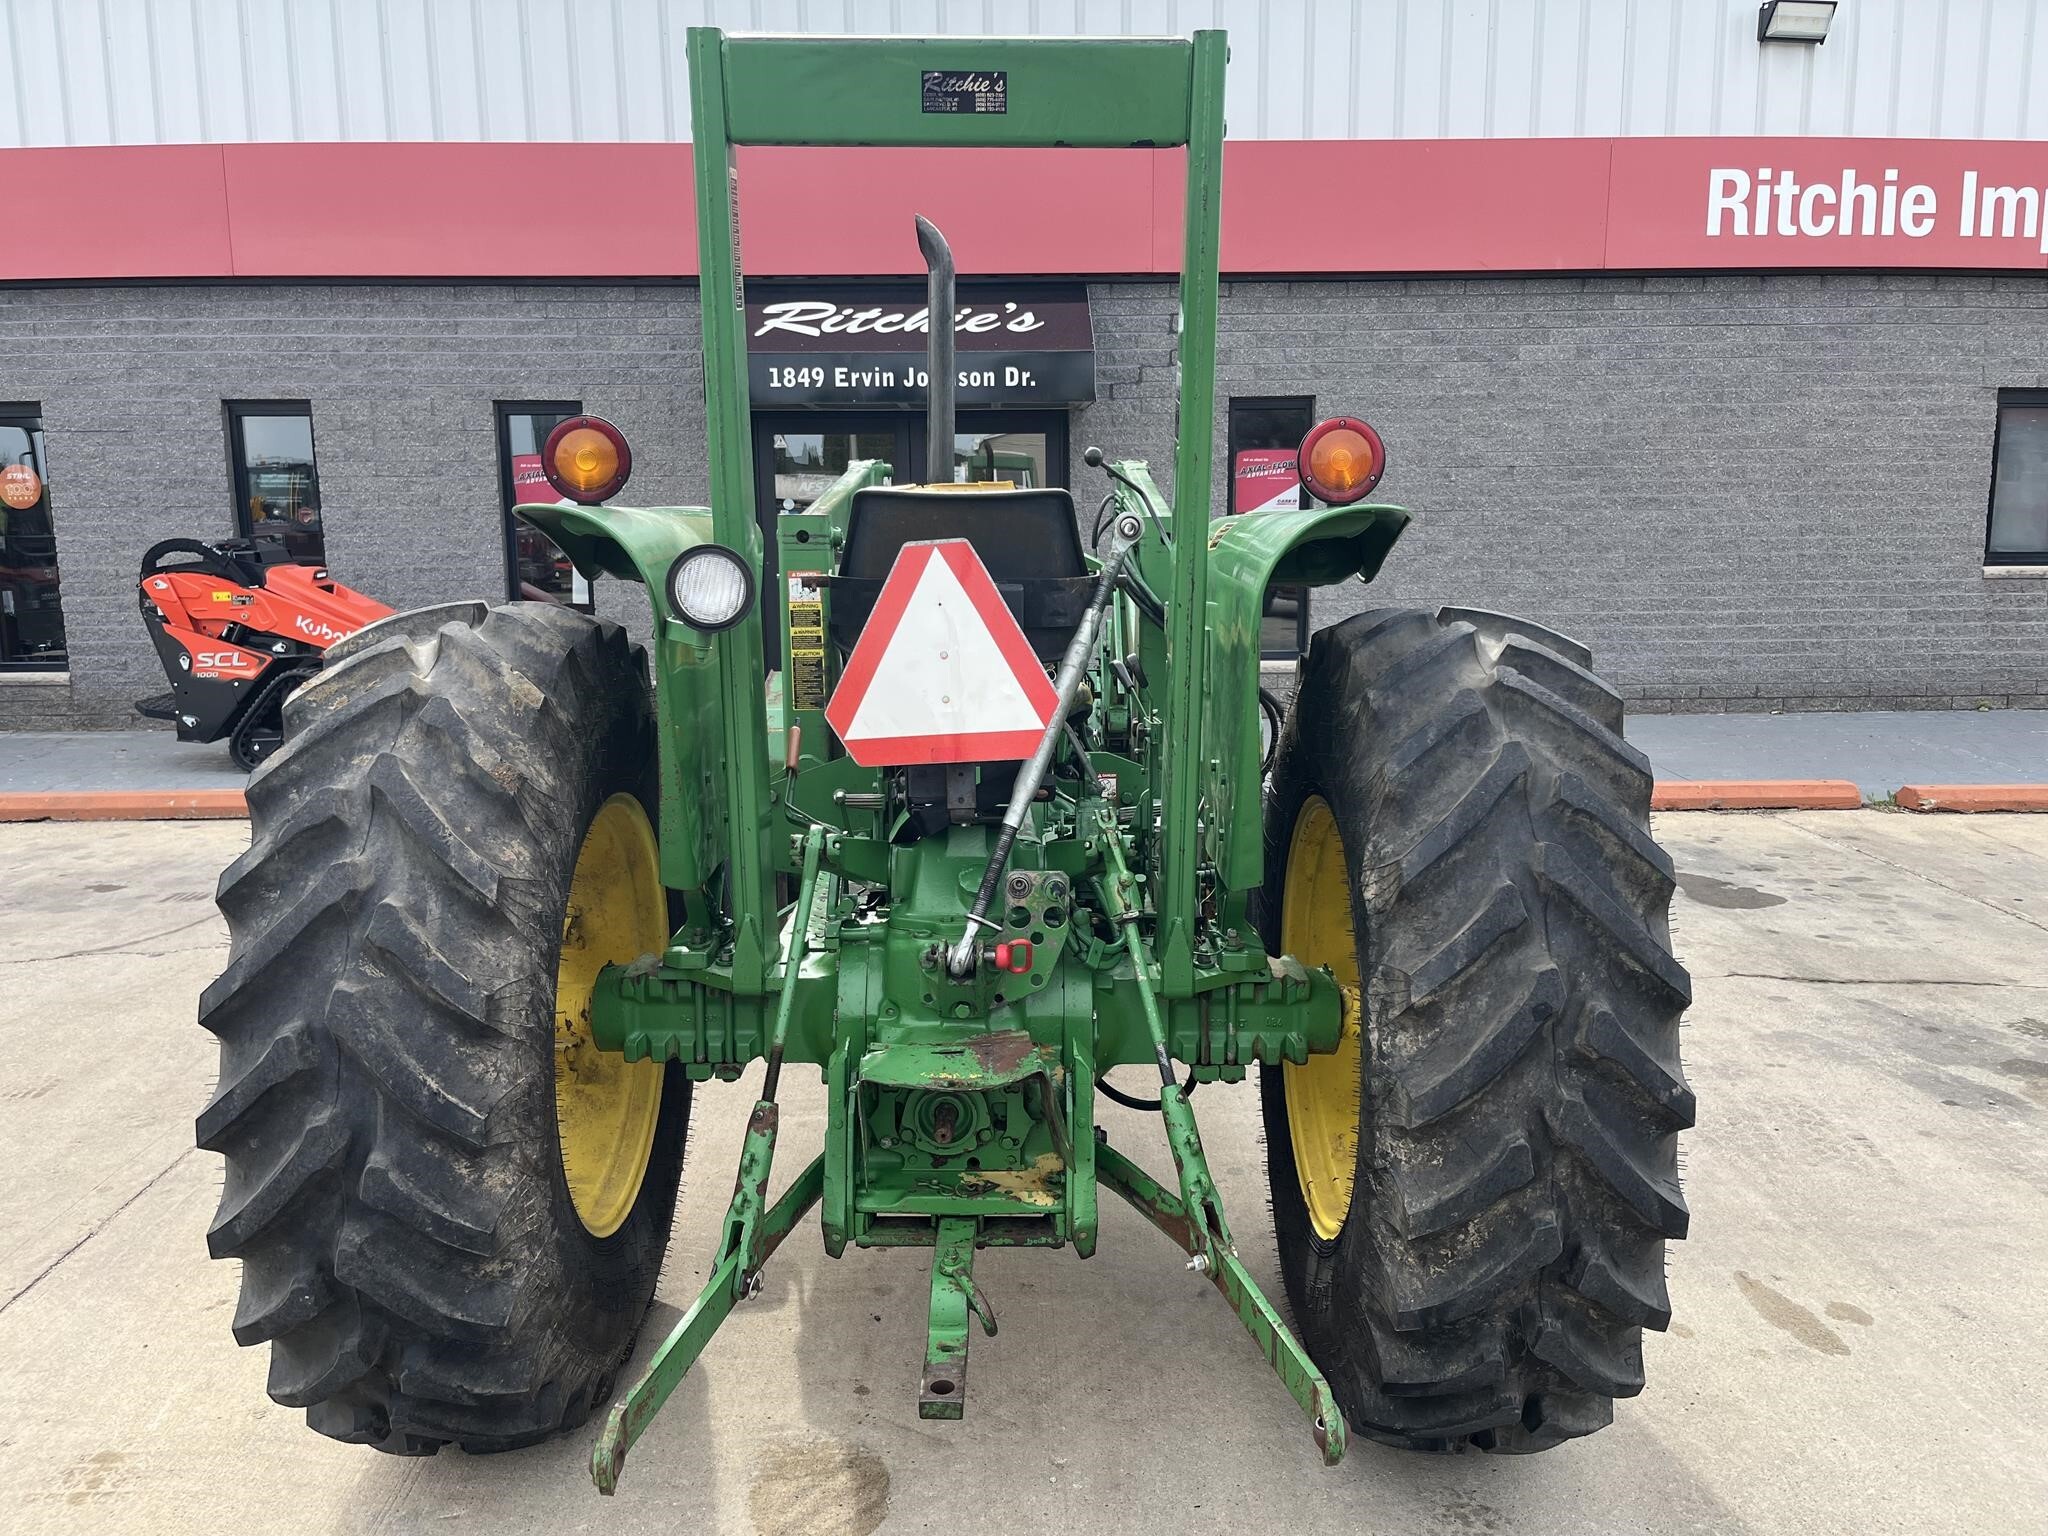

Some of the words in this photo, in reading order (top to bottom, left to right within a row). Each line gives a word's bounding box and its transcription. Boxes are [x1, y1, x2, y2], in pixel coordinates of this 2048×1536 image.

[924, 72, 1005, 92] Ritchie's
[1706, 167, 1936, 238] Ritchie
[1959, 170, 2047, 254] Im
[769, 367, 824, 388] 1849
[835, 367, 895, 388] Ervin
[903, 367, 996, 388] Joson
[1005, 367, 1036, 388] Dr.
[296, 615, 352, 643] Kubo
[196, 651, 248, 667] SCL
[197, 671, 219, 679] 1000
